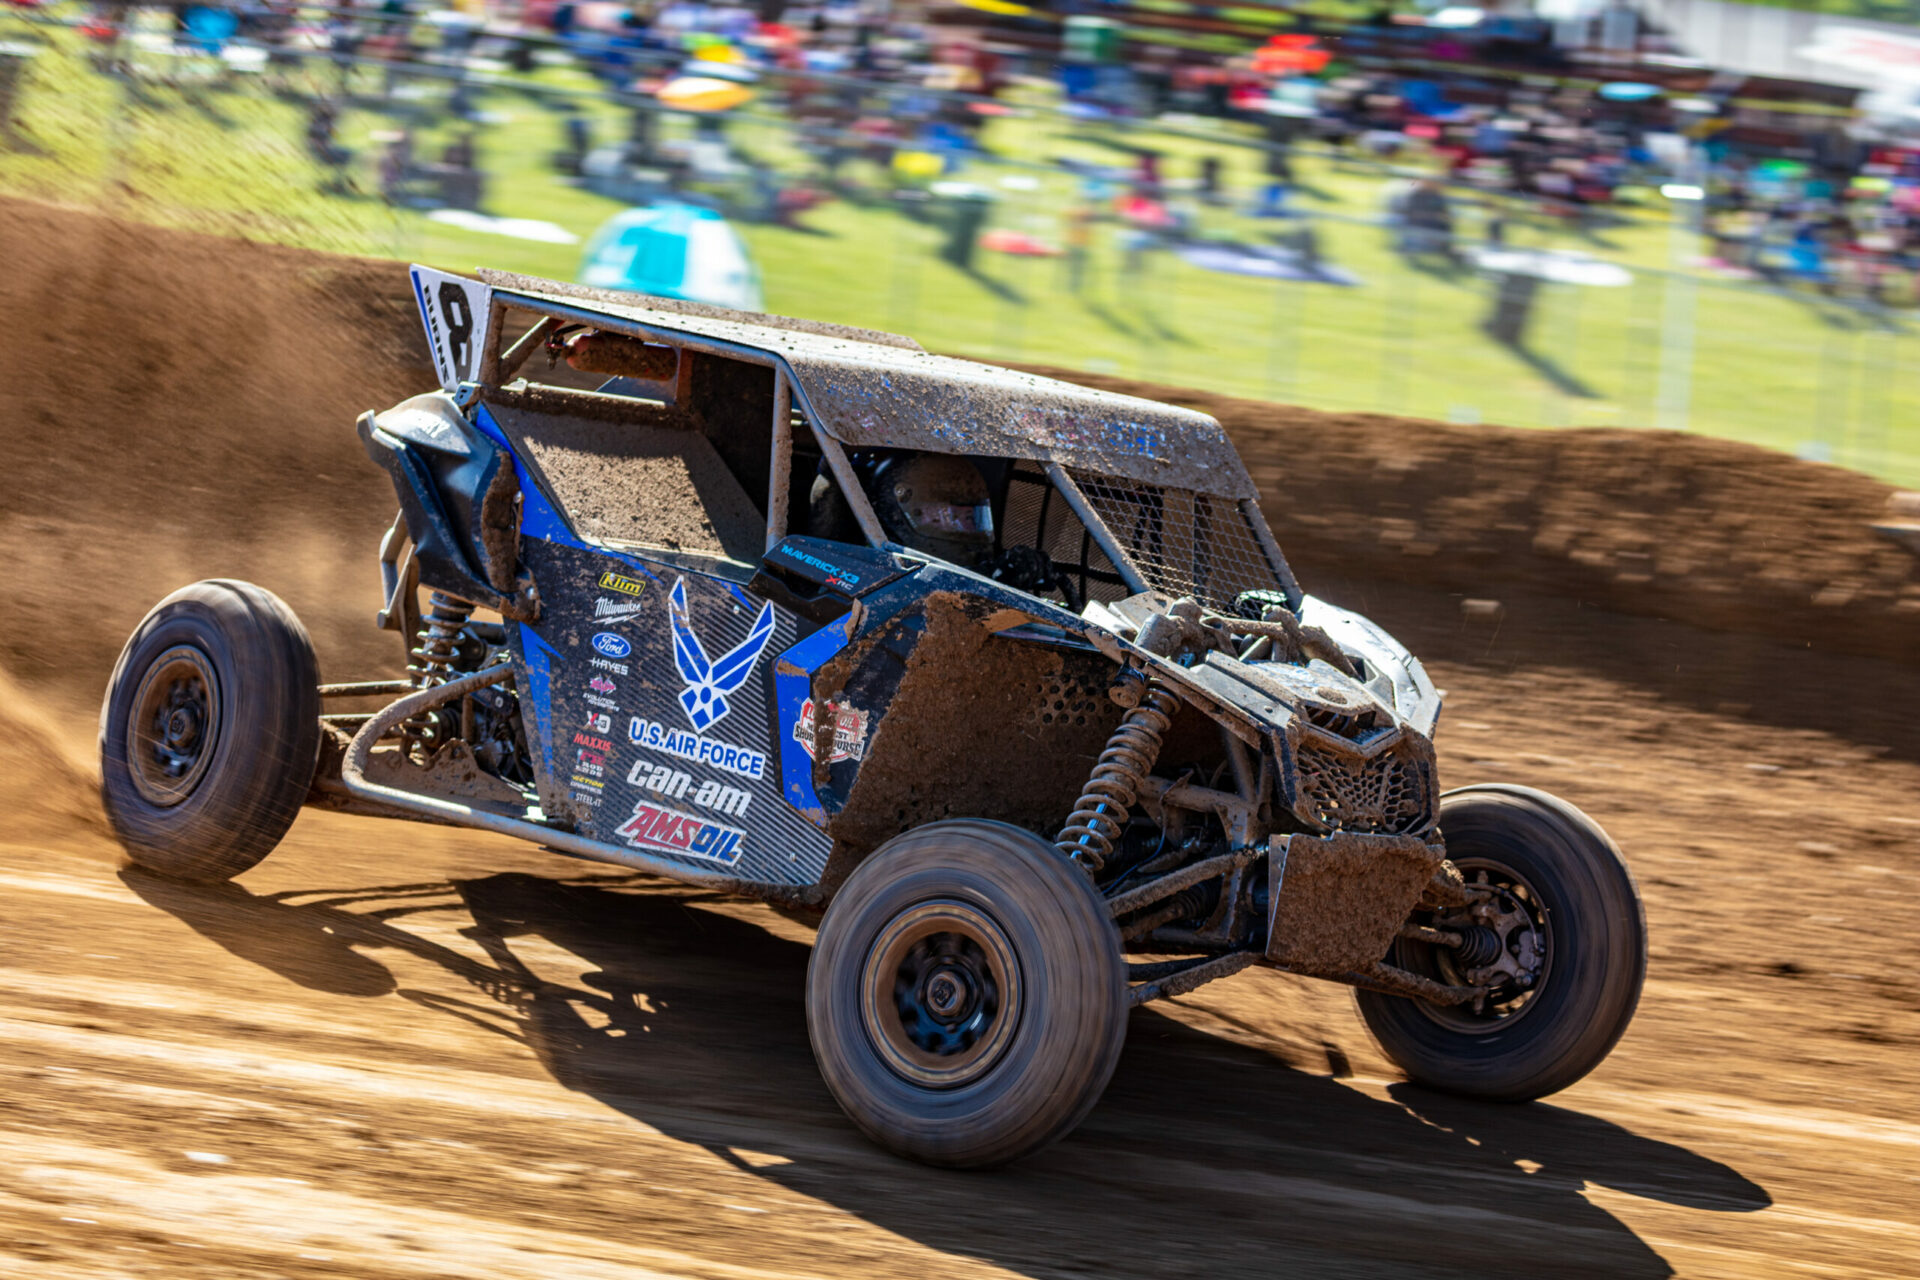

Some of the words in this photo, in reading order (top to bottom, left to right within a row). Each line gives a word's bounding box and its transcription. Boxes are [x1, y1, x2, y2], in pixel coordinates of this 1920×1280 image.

[438, 281, 474, 383] 8
[781, 544, 841, 576] MAVERICK
[839, 570, 860, 584] X3
[594, 596, 642, 617] Milwaukee
[598, 635, 625, 655] Ford
[588, 657, 628, 675] HAYES
[582, 692, 616, 706] EVOLUTION
[573, 733, 613, 751] MAXXIS
[631, 721, 663, 747] U.S.
[665, 731, 697, 756] AIR
[699, 739, 763, 776] FORCE
[623, 804, 742, 863] AMSOIL
